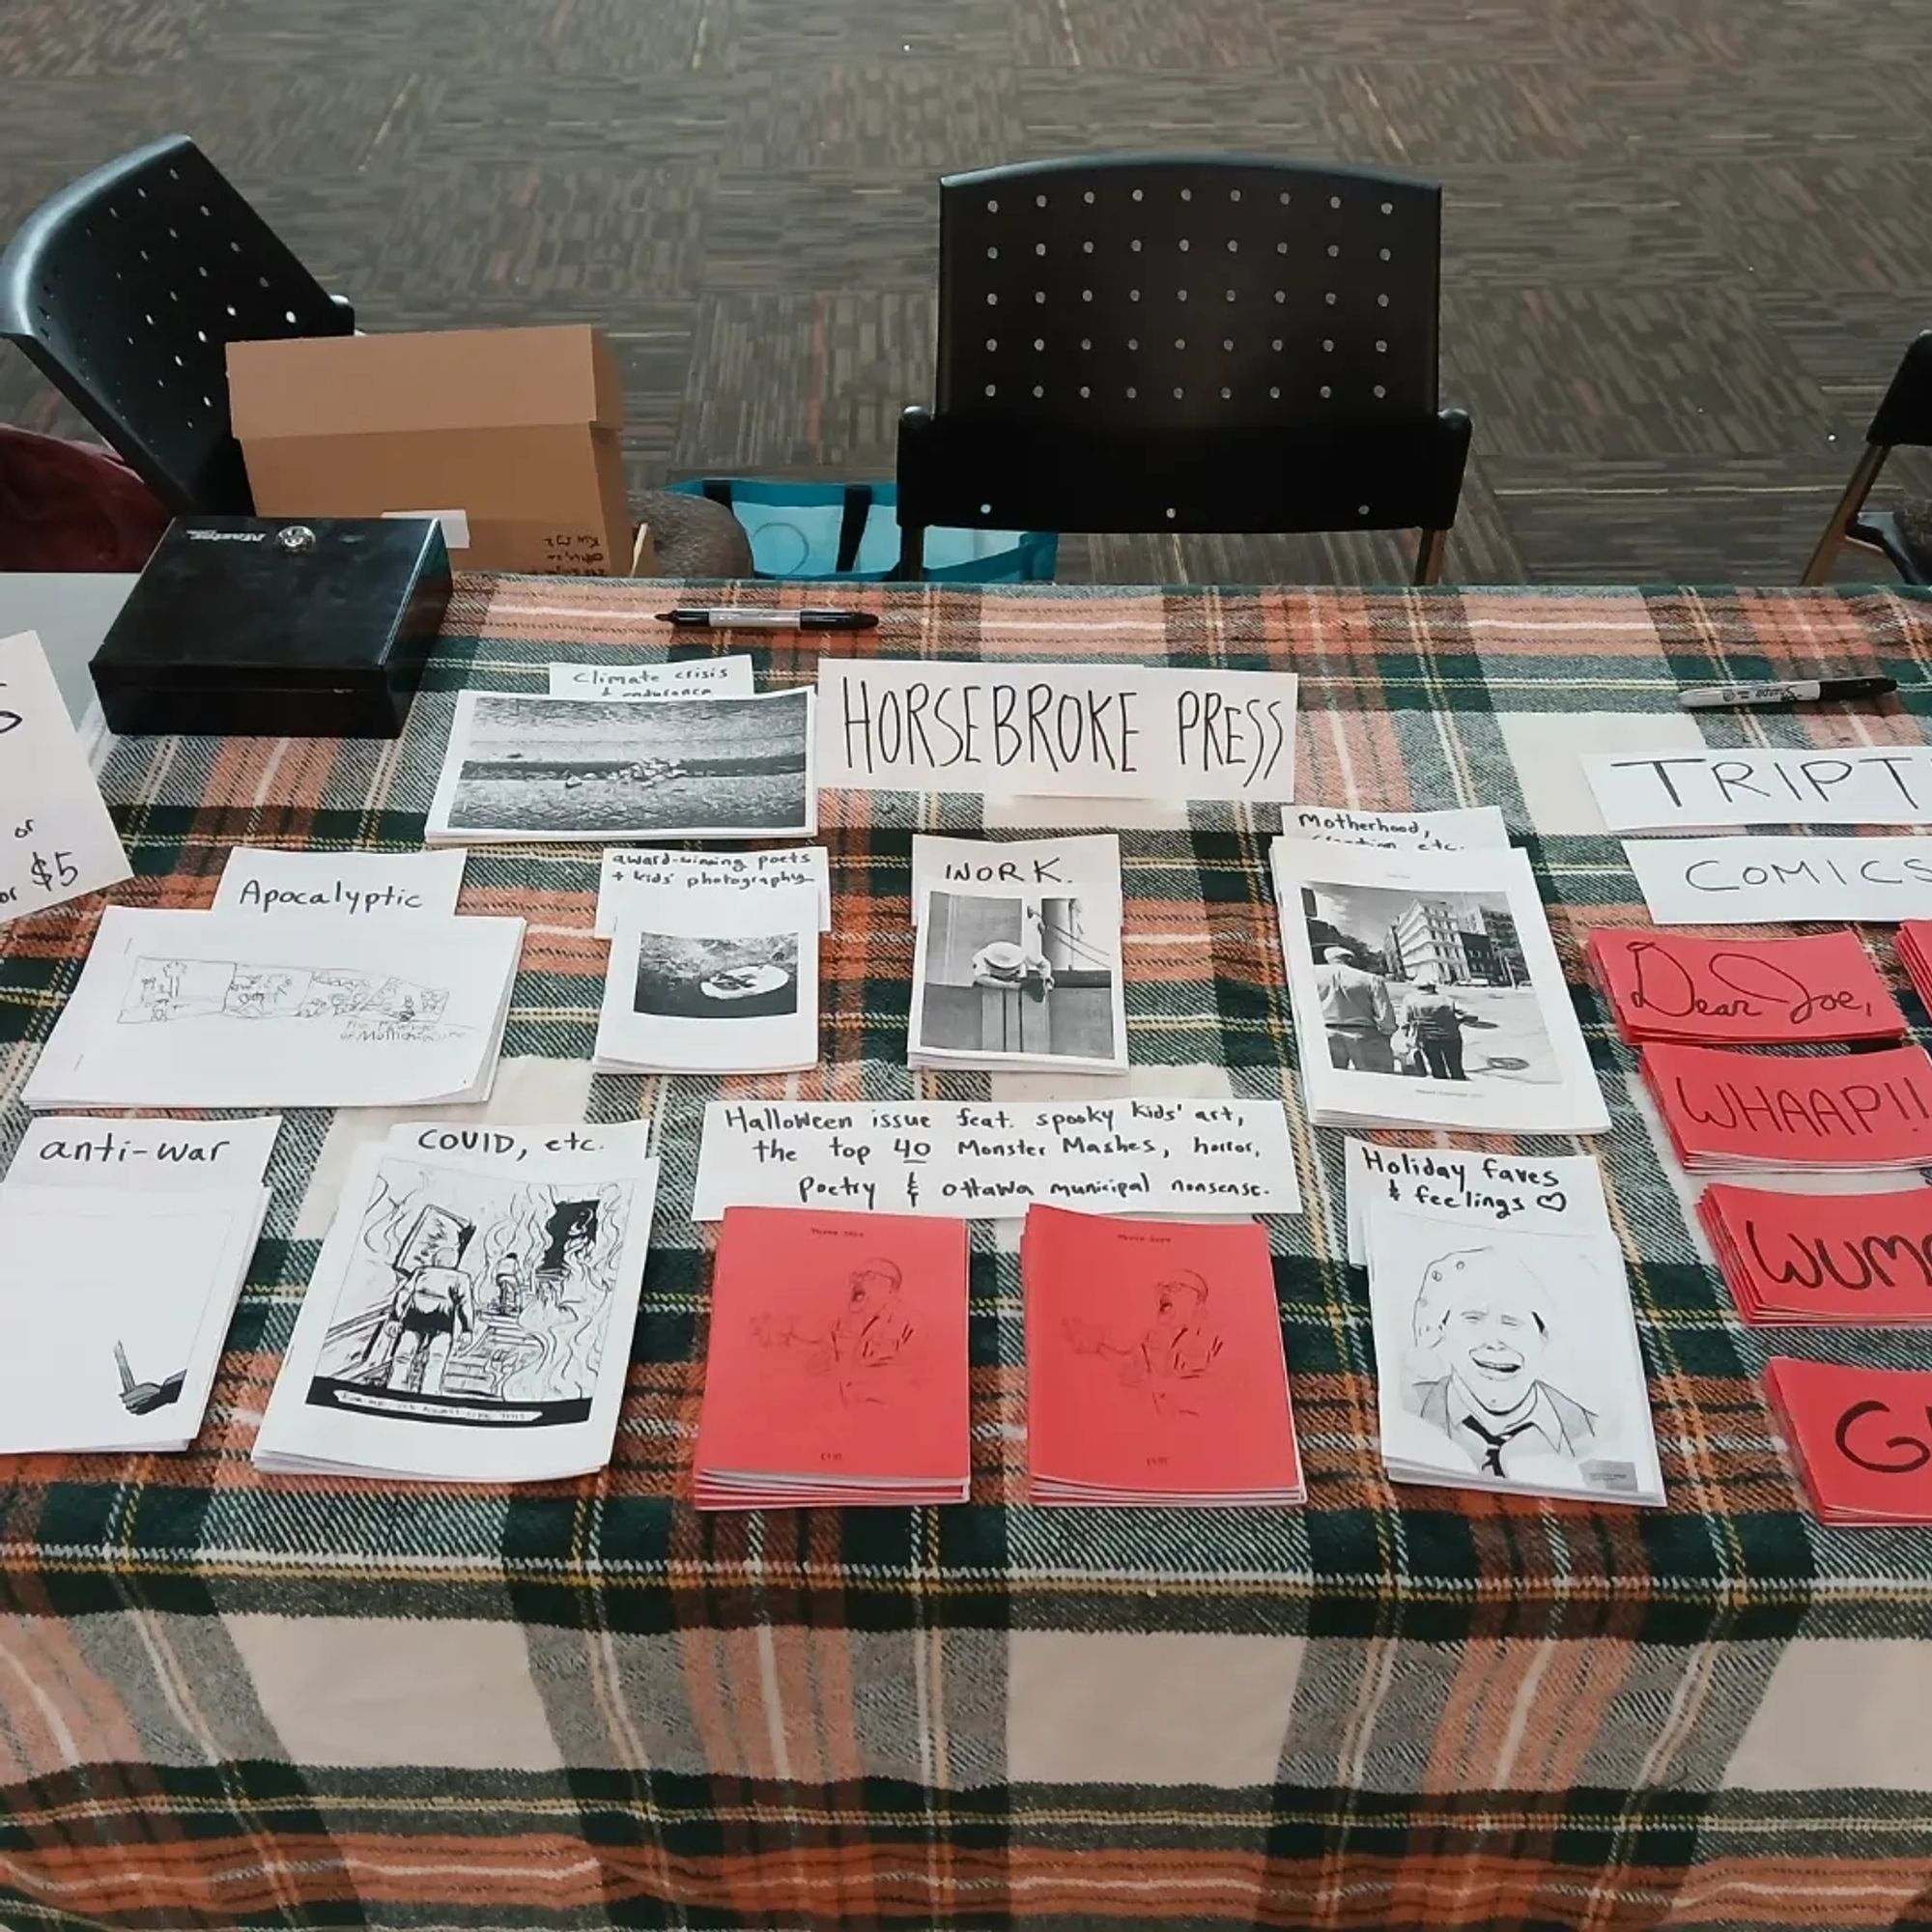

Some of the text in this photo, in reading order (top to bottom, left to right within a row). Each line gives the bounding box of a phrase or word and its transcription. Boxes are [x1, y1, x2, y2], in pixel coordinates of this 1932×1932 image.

[573, 667, 728, 685] Climate crisis
[842, 676, 1285, 788] HORSEBROKE PRESS
[1610, 756, 1932, 810] TRIPT
[14, 819, 34, 838] or
[1298, 813, 1431, 839] Motherhood,
[31, 851, 78, 893] $5
[612, 851, 811, 872] award-winning poets
[1685, 858, 1932, 891] COMICS
[240, 879, 423, 914] Apocalyptic
[687, 871, 816, 890] photography
[1627, 941, 1871, 1025] Dear Joe,
[725, 1105, 853, 1133] Halloween
[872, 1108, 931, 1128] issue
[1036, 1106, 1115, 1135] spooky
[1131, 1100, 1182, 1122] kids'
[1195, 1106, 1244, 1126] art,
[40, 1133, 230, 1161] anti-war
[417, 1129, 606, 1161] COVID, etc.
[753, 1138, 798, 1162] the
[829, 1136, 871, 1166] top
[894, 1138, 932, 1164] 40
[957, 1139, 1046, 1158] Monster
[1063, 1134, 1170, 1159] Mashes,
[1050, 1172, 1150, 1197] municipal
[1172, 1179, 1270, 1197] nonsense.
[1362, 1147, 1560, 1192] Holiday faves
[1415, 1184, 1526, 1220] feelings
[1746, 1219, 1932, 1291] WUM
[1835, 1401, 1932, 1473] G
